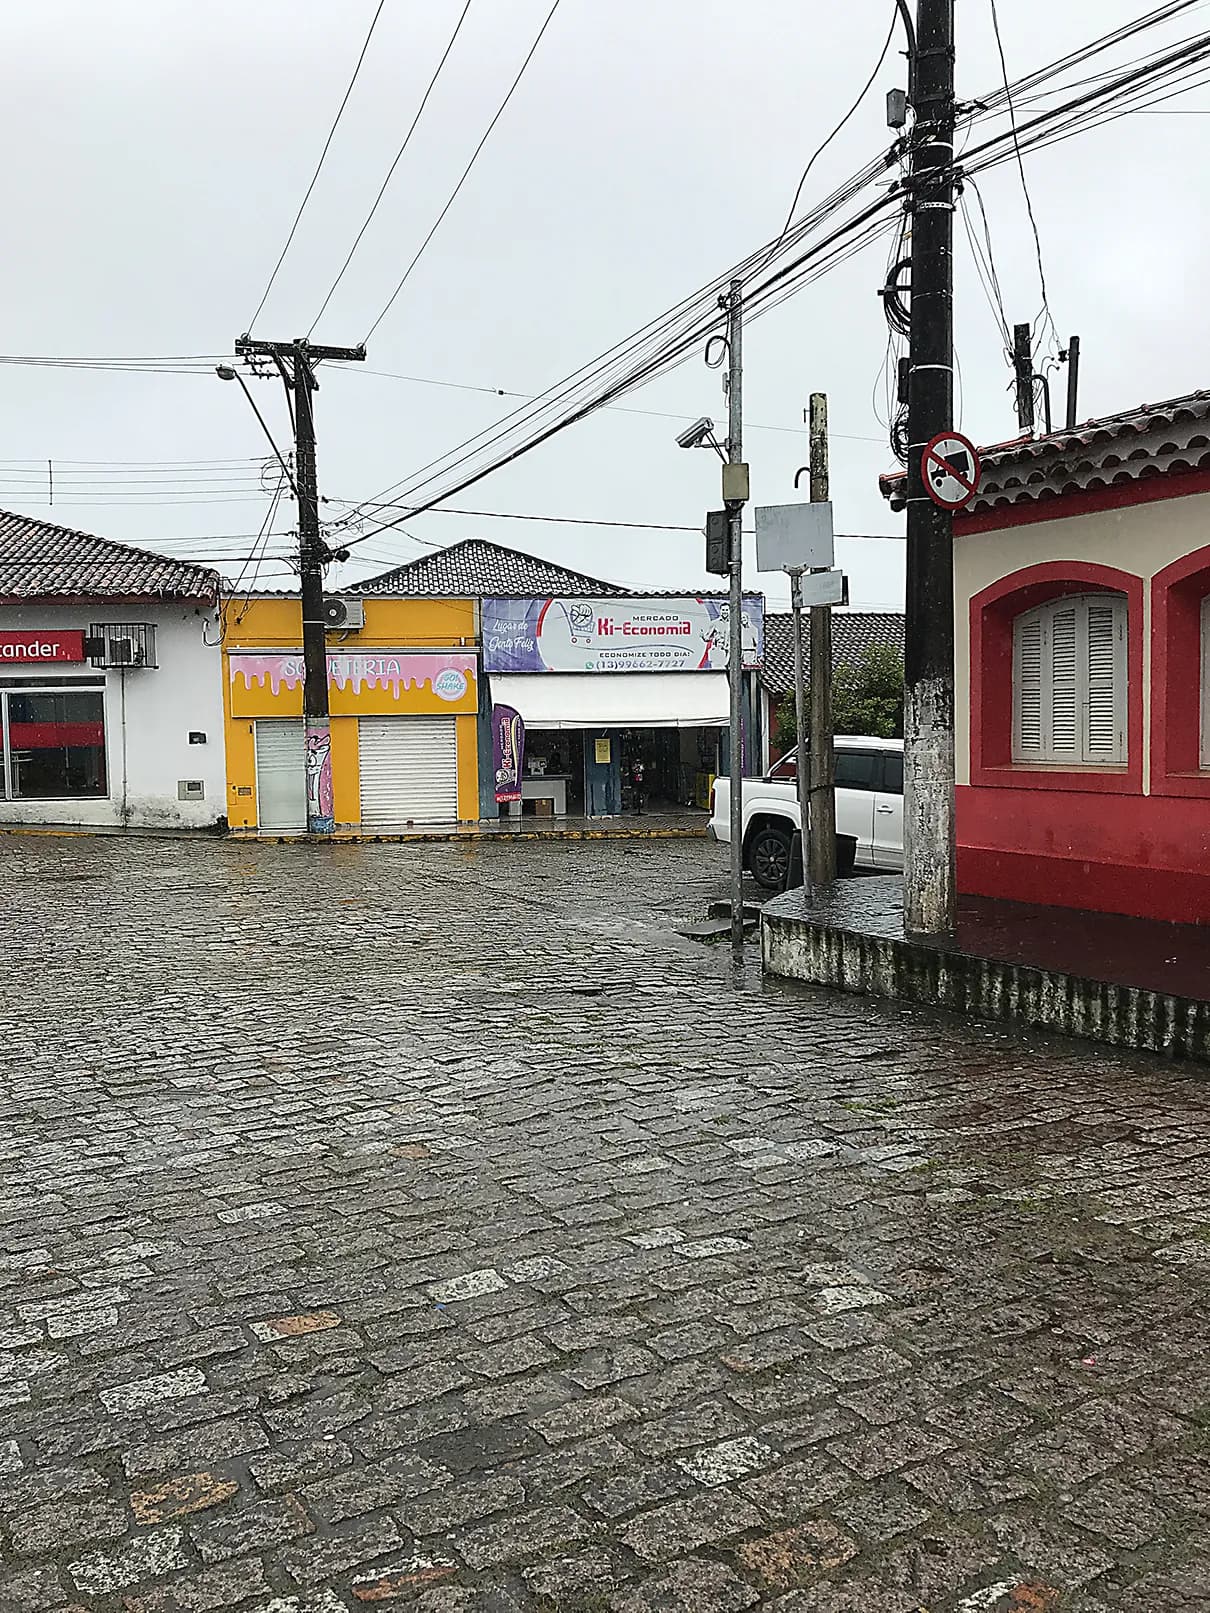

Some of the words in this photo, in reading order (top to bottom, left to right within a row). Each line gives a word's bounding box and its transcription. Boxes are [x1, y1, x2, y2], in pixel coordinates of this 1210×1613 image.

[492, 619, 517, 634] Lugar
[597, 618, 691, 636] Ki-Economia
[514, 636, 534, 652] Feliz
[436, 682, 465, 690] SHAKE
